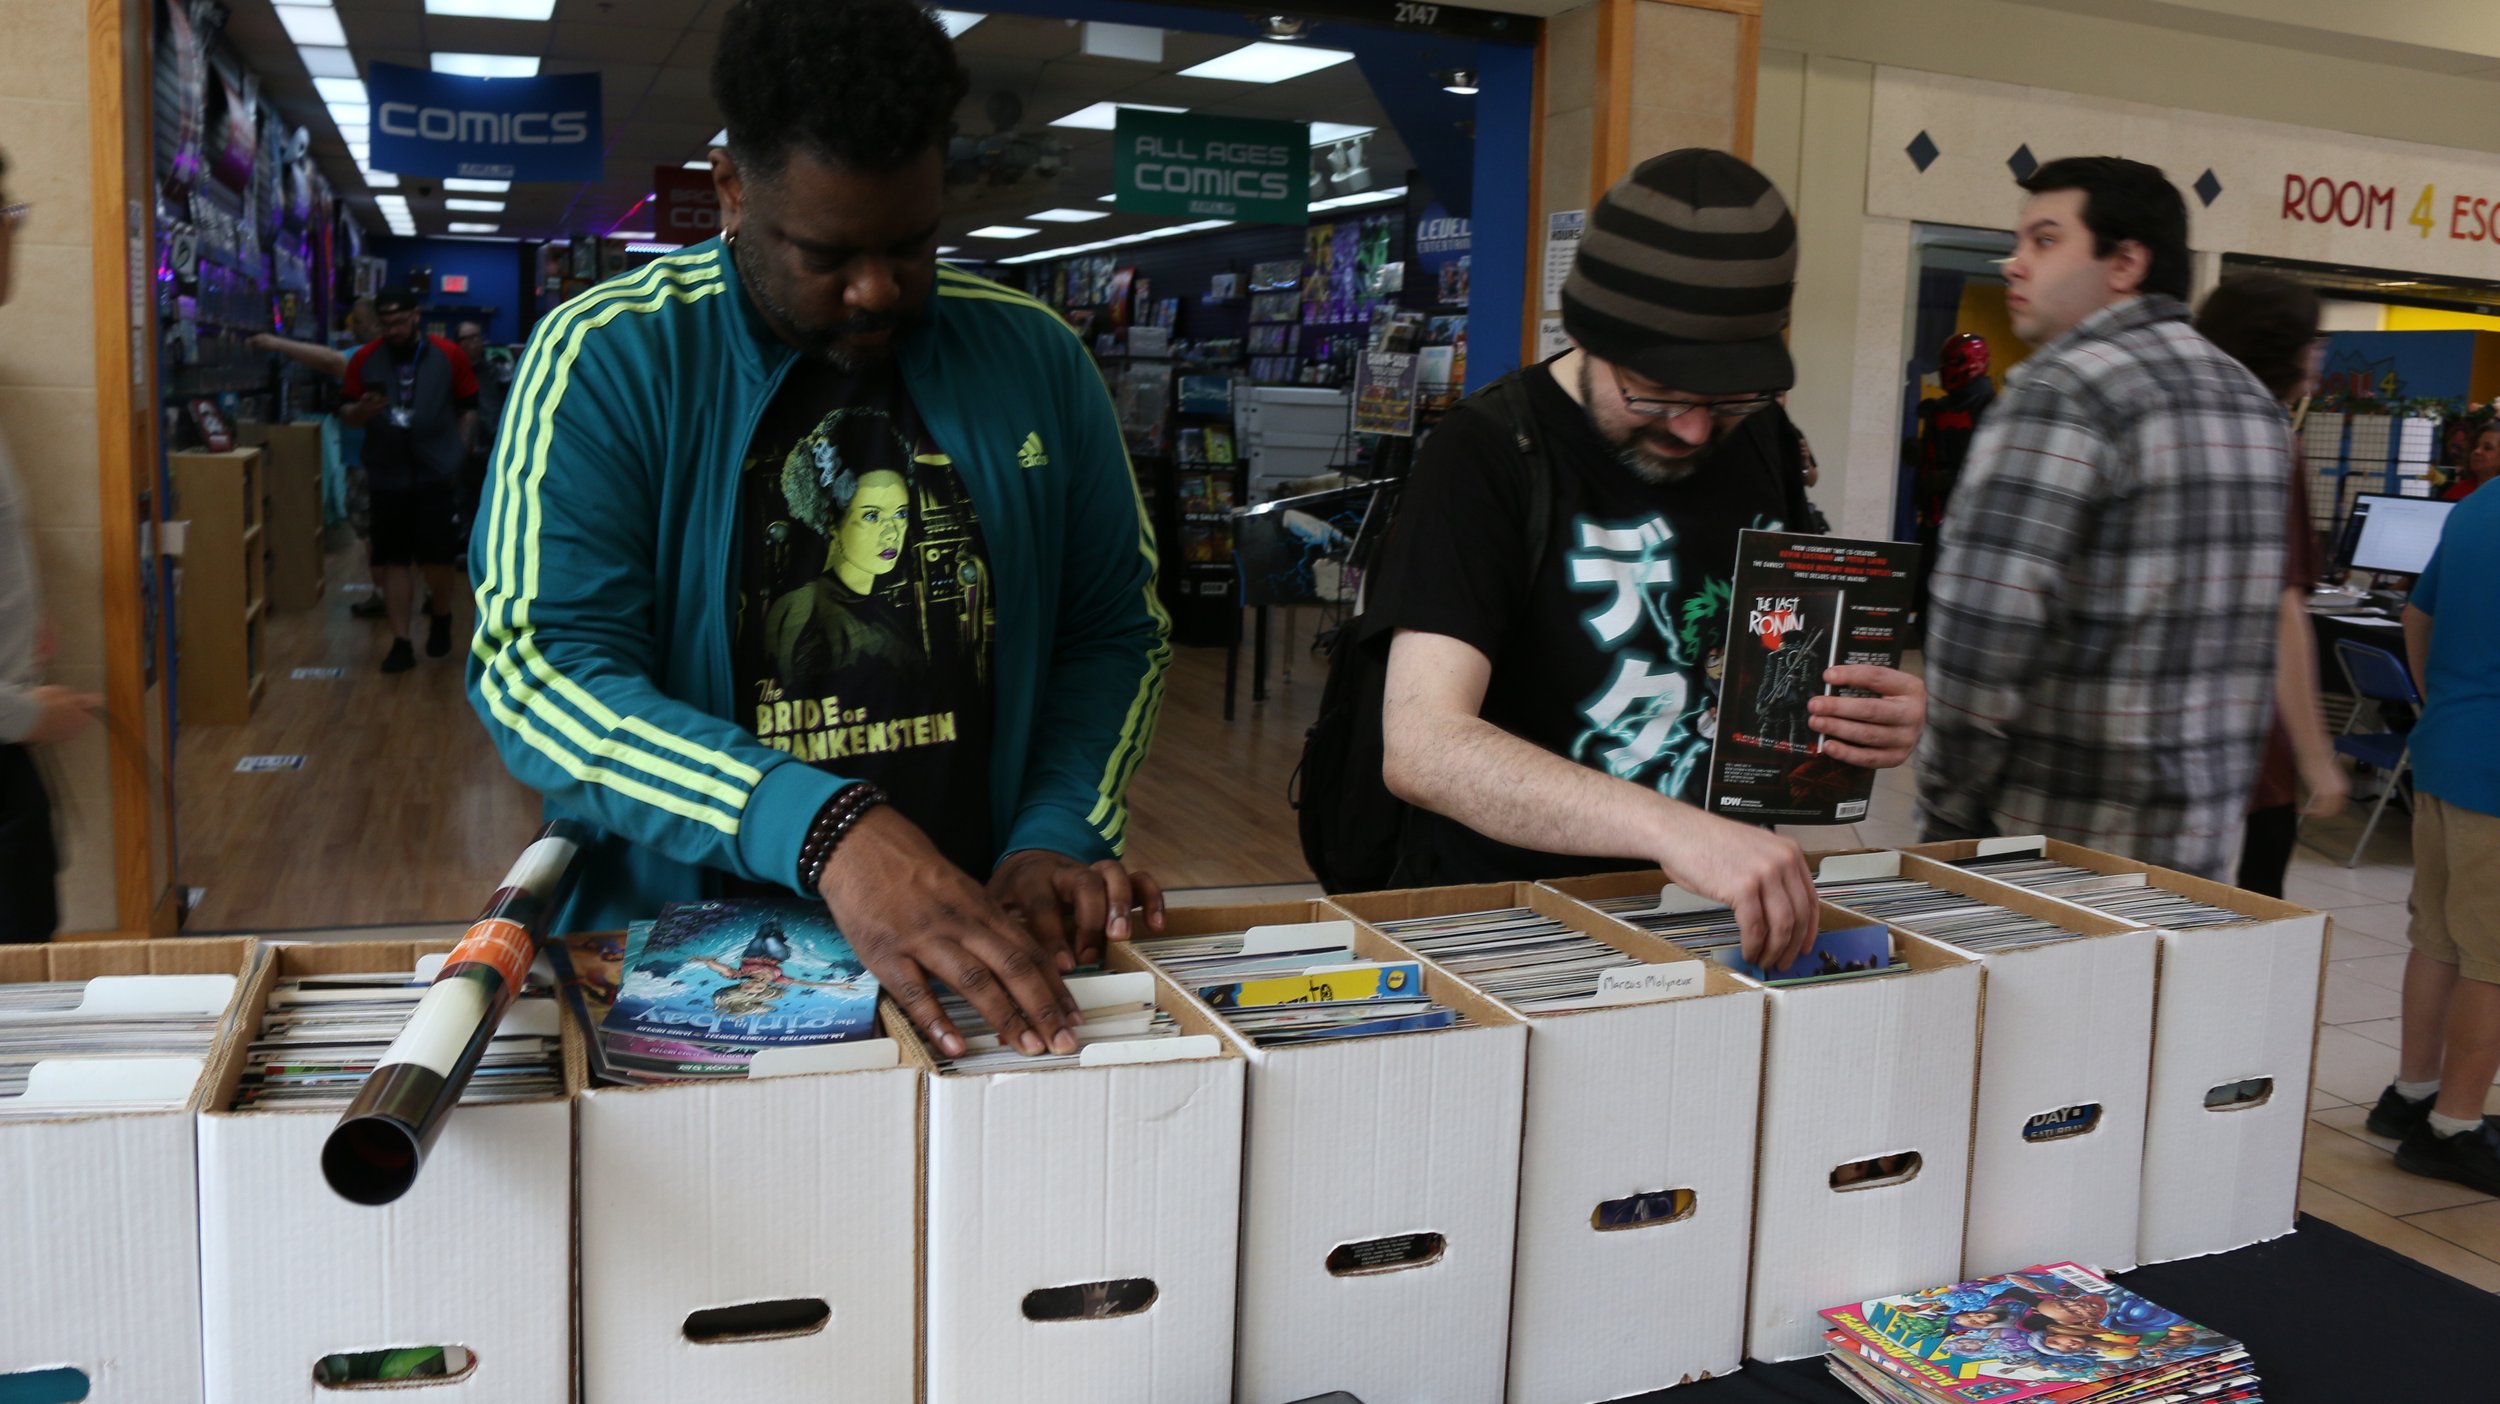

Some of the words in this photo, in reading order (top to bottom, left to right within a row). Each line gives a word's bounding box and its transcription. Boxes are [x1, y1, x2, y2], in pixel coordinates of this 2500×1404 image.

[1394, 3, 1439, 25] 2147
[378, 102, 588, 145] COMICS
[1135, 135, 1198, 160] ALL
[1206, 141, 1289, 166] AGES
[1135, 163, 1289, 200] COMICS
[671, 207, 721, 229] CO
[2281, 174, 2395, 231] ROOM
[2408, 182, 2436, 240] 4
[1416, 217, 1472, 241] LEVEL
[1551, 229, 1581, 242] HOURS
[1755, 596, 1773, 612] THE
[1775, 596, 1801, 613] LAST
[1748, 610, 1805, 637] RONIN
[1571, 516, 1688, 774] デク
[755, 678, 784, 702] The
[756, 695, 840, 736] BRIDE
[842, 706, 868, 723] OF
[1720, 796, 1743, 806] IDW
[1603, 976, 1641, 990] Marcus
[630, 1006, 723, 1034] bay
[751, 1006, 839, 1035] girl
[1911, 1362, 1961, 1387] AGES
